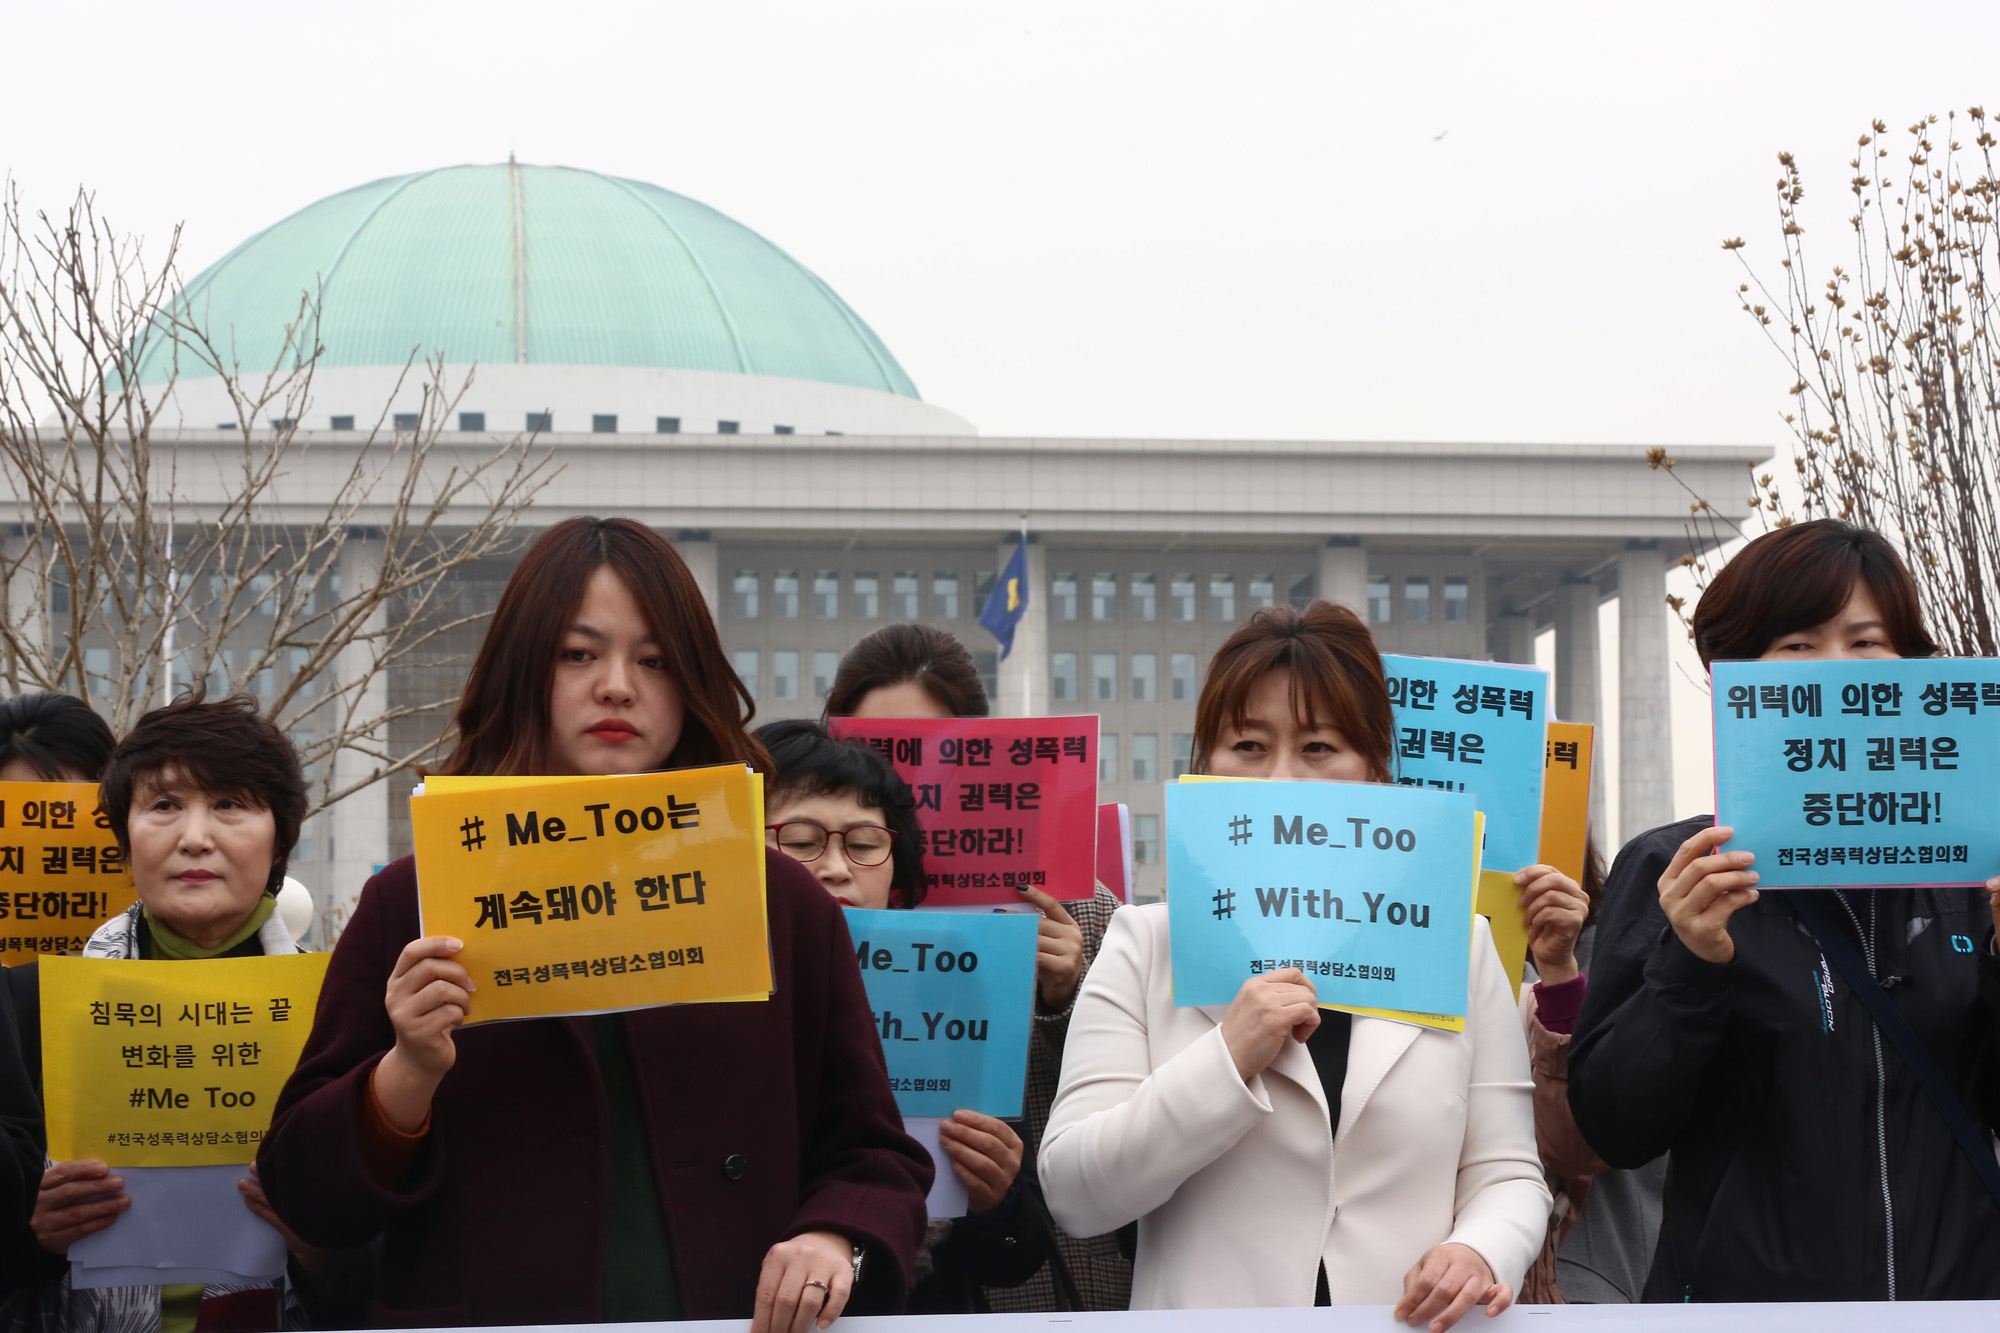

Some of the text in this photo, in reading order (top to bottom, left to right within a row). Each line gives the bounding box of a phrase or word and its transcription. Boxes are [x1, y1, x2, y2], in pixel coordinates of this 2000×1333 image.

[1452, 684, 1534, 720] 성폭력
[1727, 684, 1822, 719] 위력에
[1841, 682, 1903, 717] 의한
[846, 736, 1087, 767] 력에 의한 성폭력
[1400, 727, 1485, 764] 권력은
[1783, 736, 1960, 772] 정치 권력은
[959, 782, 1041, 811] 권력은
[1803, 792, 1941, 826] 중단하라!
[22, 801, 77, 829] 의한
[459, 794, 701, 852] # Me_Too는
[1228, 814, 1417, 852] # Me_Too
[42, 846, 123, 874] 권력은
[1778, 845, 1968, 866] 전국성폭력상담소협의회
[473, 870, 707, 930] 계속돼야 한다
[1212, 887, 1430, 928] # With_You
[493, 946, 705, 987] 전국성폭력상담소협의회
[89, 997, 292, 1027] 침묵의 시대는 끝
[122, 1041, 261, 1068] 변화를 위한
[129, 1086, 256, 1109] #Me Too
[108, 1130, 267, 1146] #전국성폭력상담소협의
